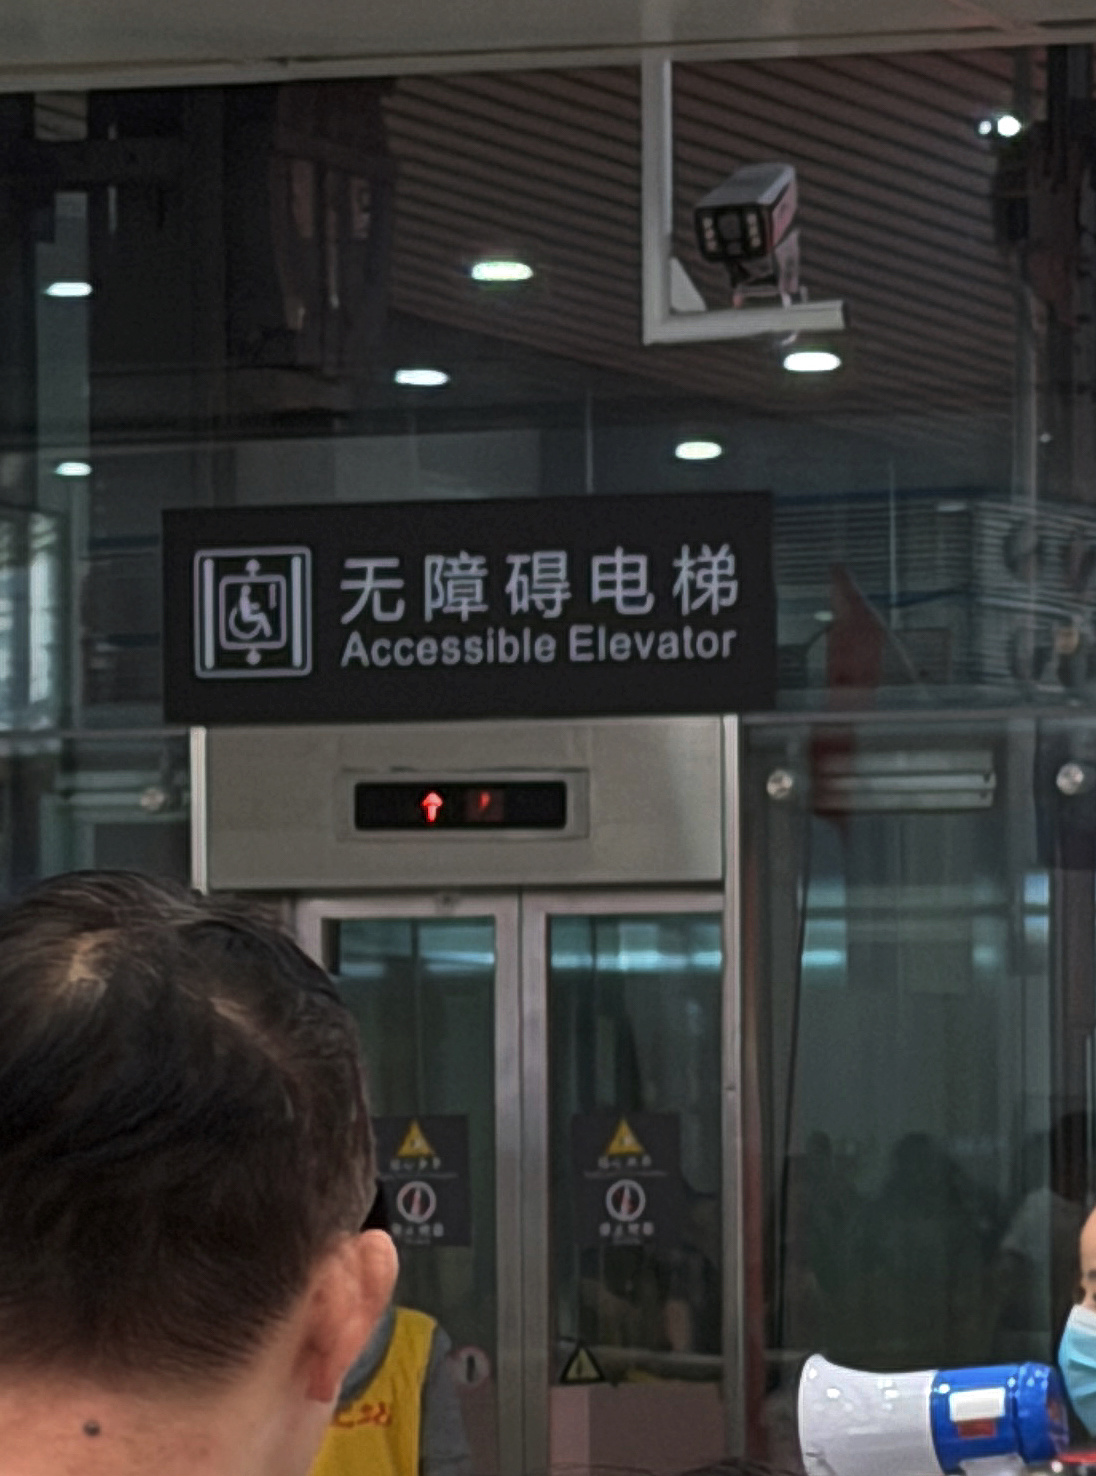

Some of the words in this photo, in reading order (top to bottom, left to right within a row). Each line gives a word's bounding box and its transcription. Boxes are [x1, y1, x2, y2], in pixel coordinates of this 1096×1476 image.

[340, 543, 739, 624] 无障碍电梯
[340, 626, 557, 667] Accessible
[569, 623, 738, 662] Elevator
